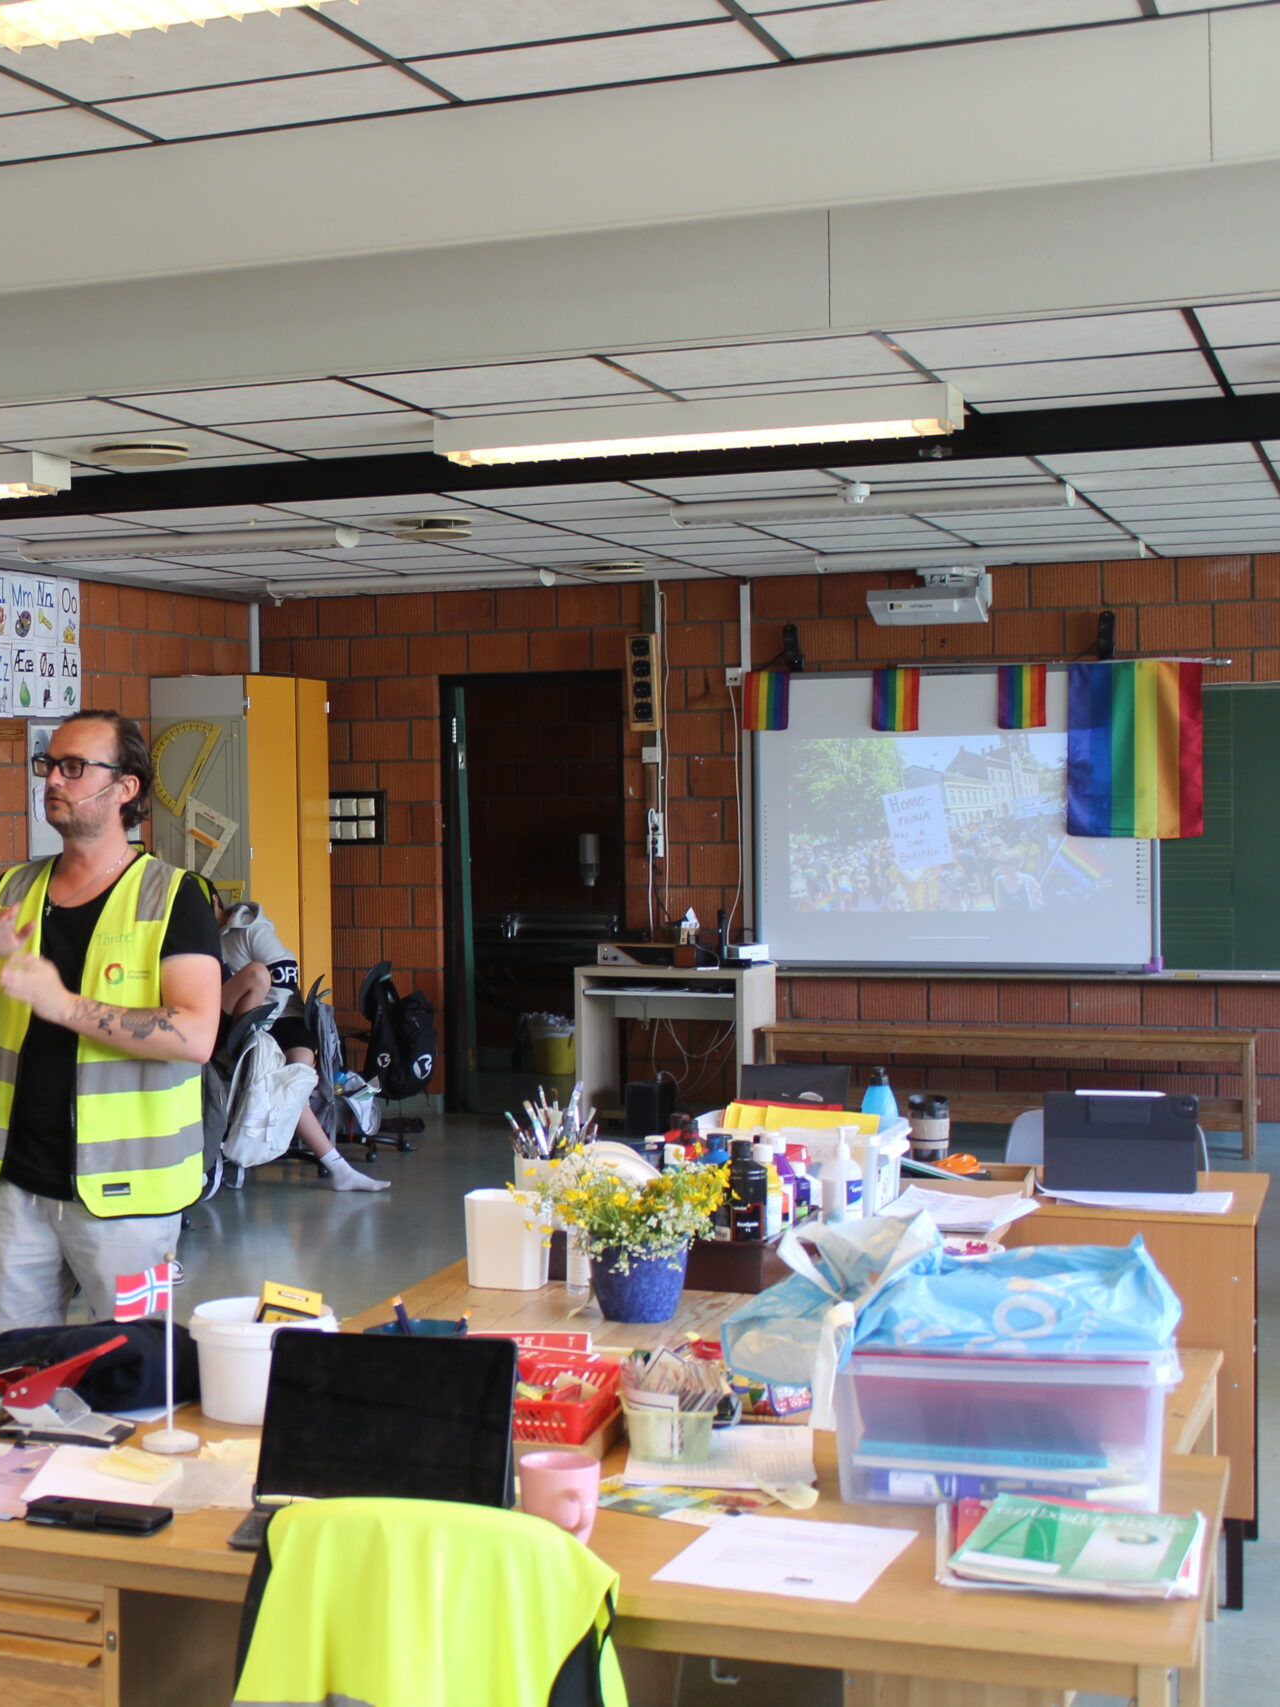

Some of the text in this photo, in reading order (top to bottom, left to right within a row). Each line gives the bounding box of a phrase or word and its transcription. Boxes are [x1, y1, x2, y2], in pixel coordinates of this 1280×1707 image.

[11, 584, 34, 608] Mm
[37, 581, 54, 607] Nn
[61, 587, 78, 614] Oo
[14, 649, 34, 672] Ææ
[40, 652, 55, 677] Øø
[270, 966, 298, 983] OR
